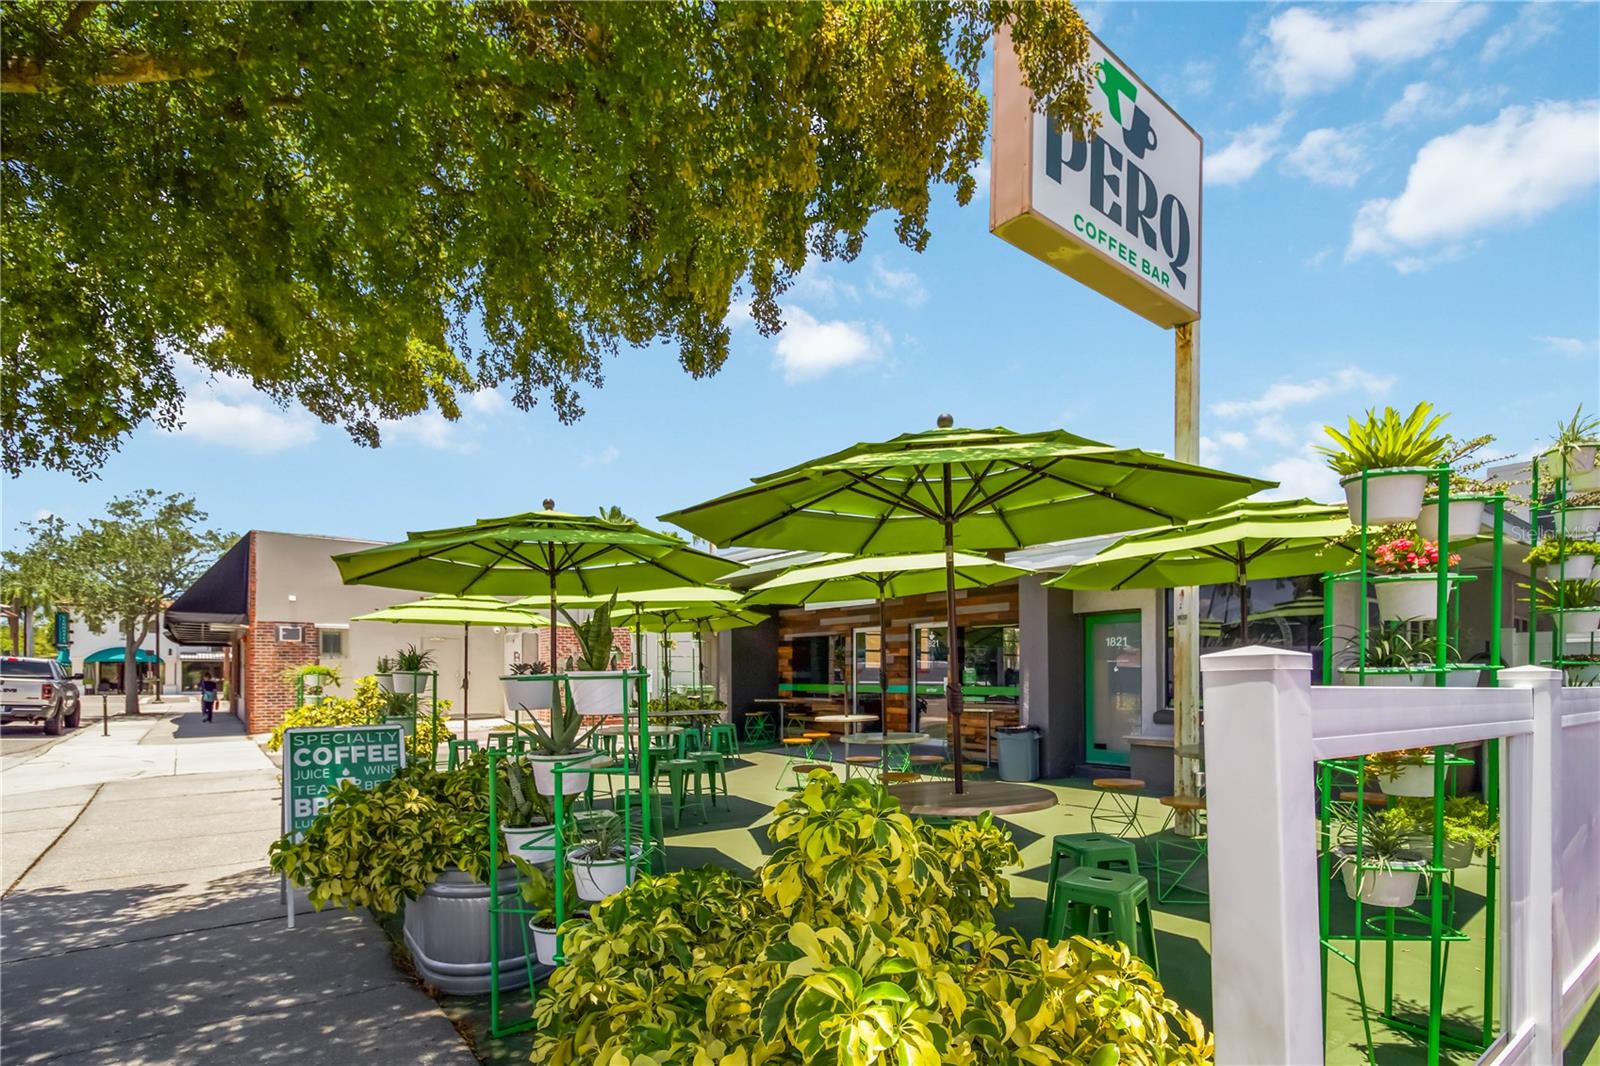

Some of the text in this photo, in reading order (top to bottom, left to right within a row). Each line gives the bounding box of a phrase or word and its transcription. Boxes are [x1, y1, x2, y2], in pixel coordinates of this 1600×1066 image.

[1046, 95, 1190, 291] PERQ
[1073, 213, 1170, 289] COFFEE BAR
[1105, 636, 1129, 647] 1821
[293, 731, 398, 746] SPECIALTY
[293, 743, 399, 767] COFFEE
[294, 768, 330, 781] JUICE
[363, 763, 399, 776] WINE
[294, 784, 330, 796] TEA
